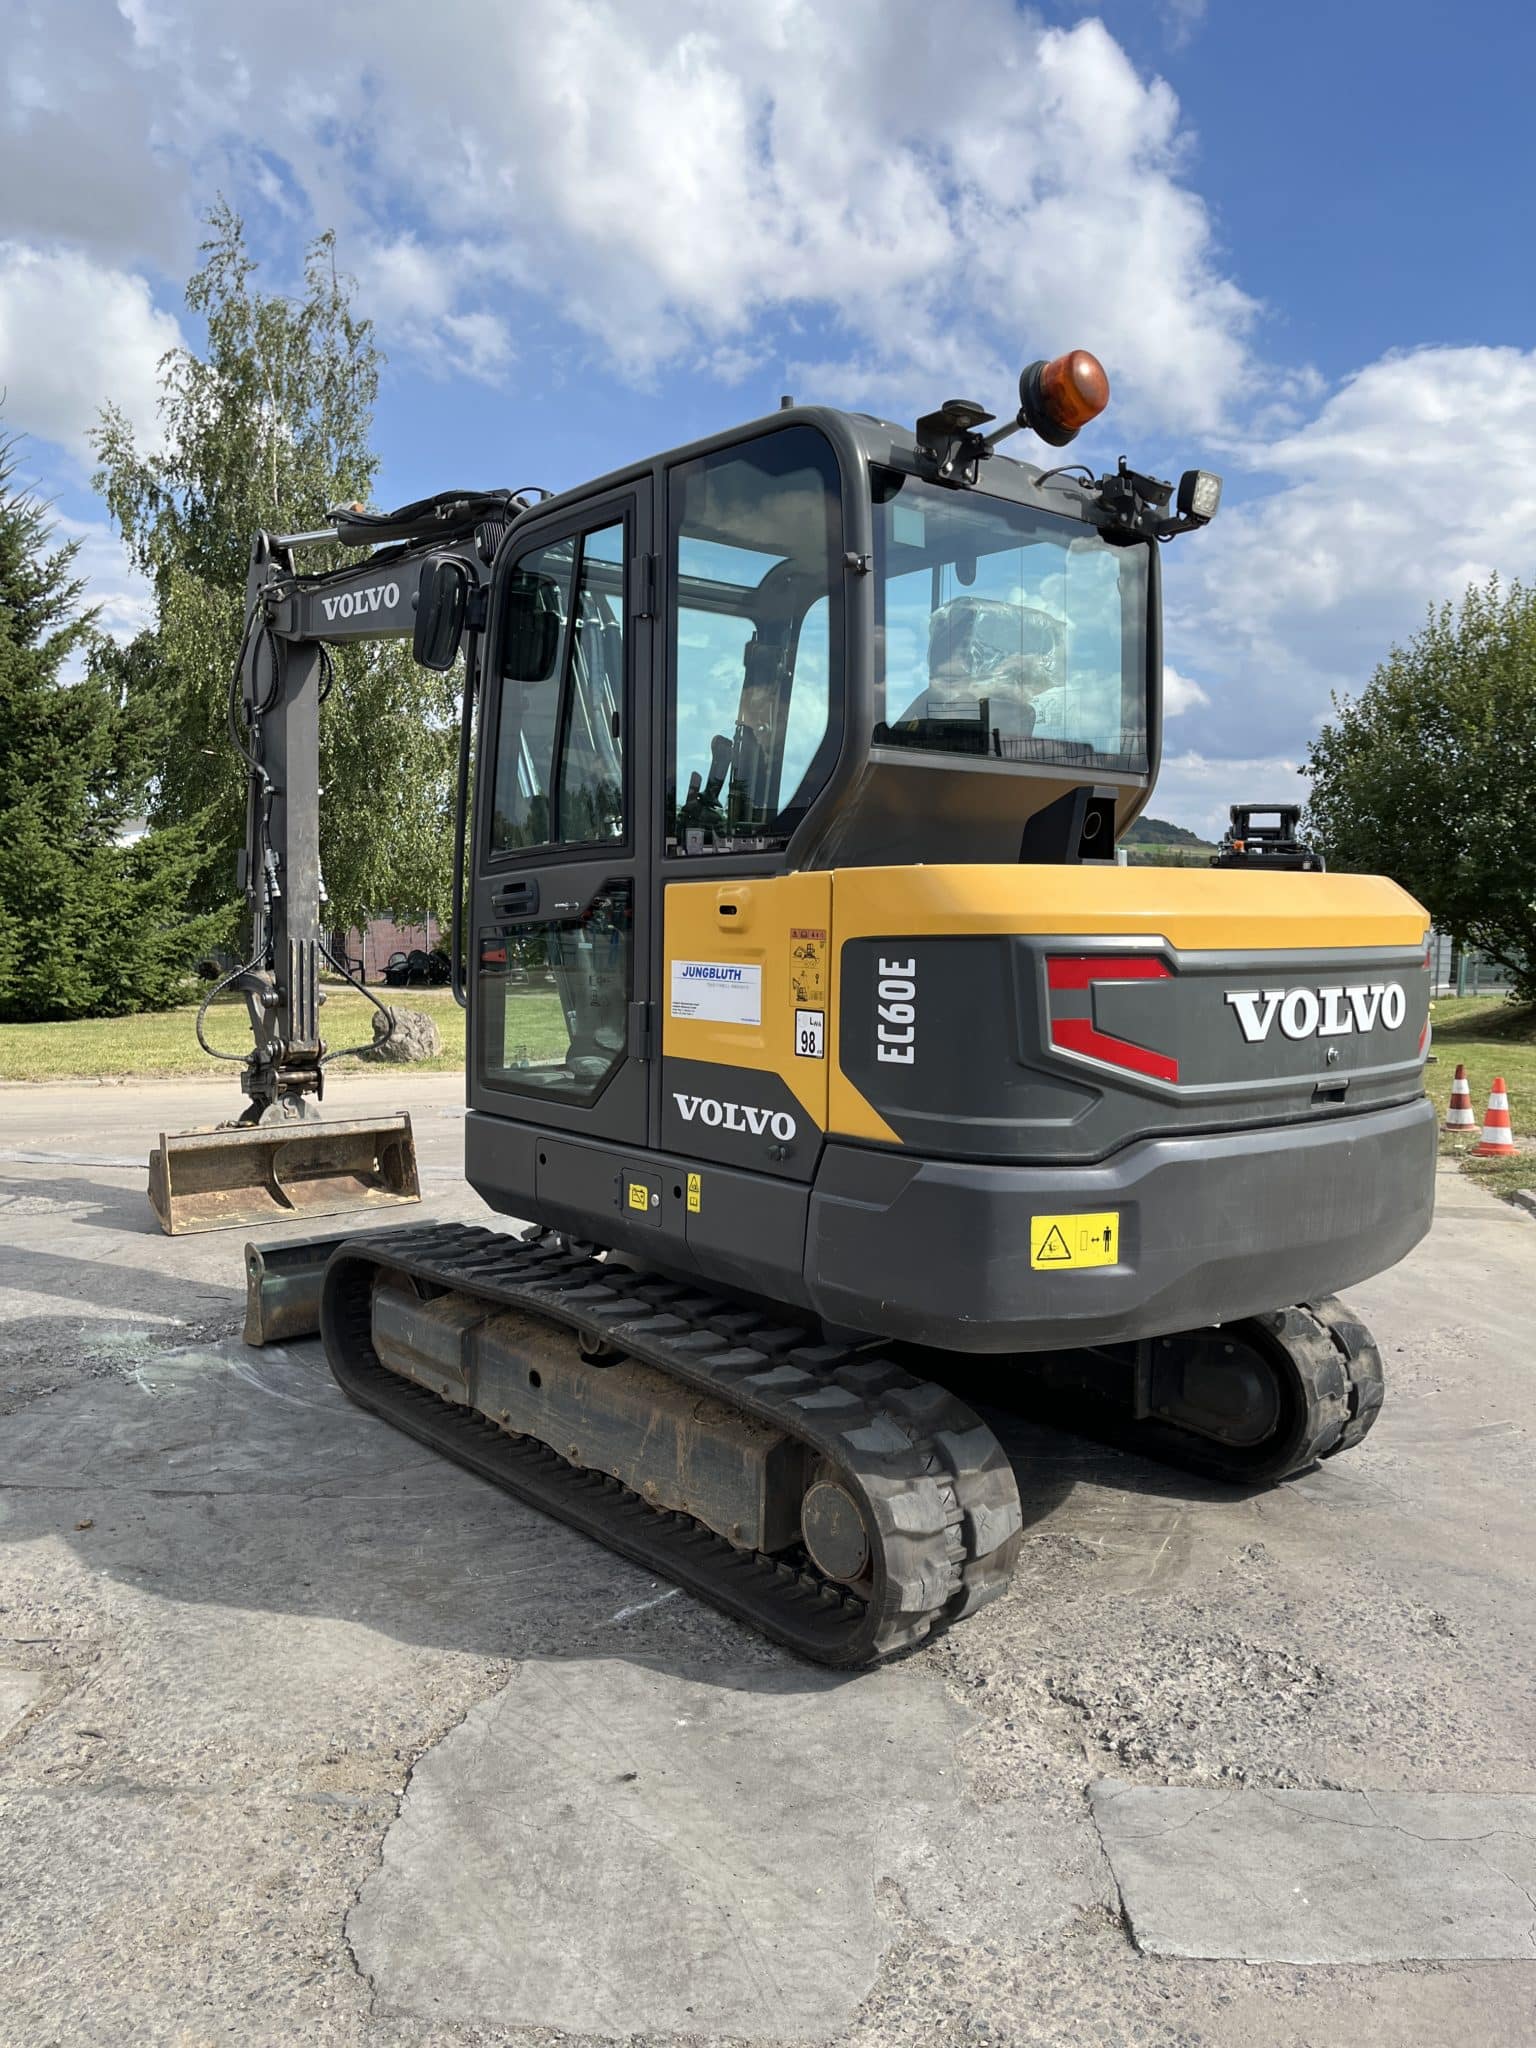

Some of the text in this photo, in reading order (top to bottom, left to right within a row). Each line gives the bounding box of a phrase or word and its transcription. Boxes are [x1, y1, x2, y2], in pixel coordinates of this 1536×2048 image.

[322, 582, 400, 620] VOLVO
[682, 966, 742, 981] JUNGBLUTH
[878, 958, 916, 1064] EC60E
[1224, 981, 1406, 1043] VOLVO
[801, 1030, 816, 1054] 98
[672, 1092, 797, 1141] VOLVO
